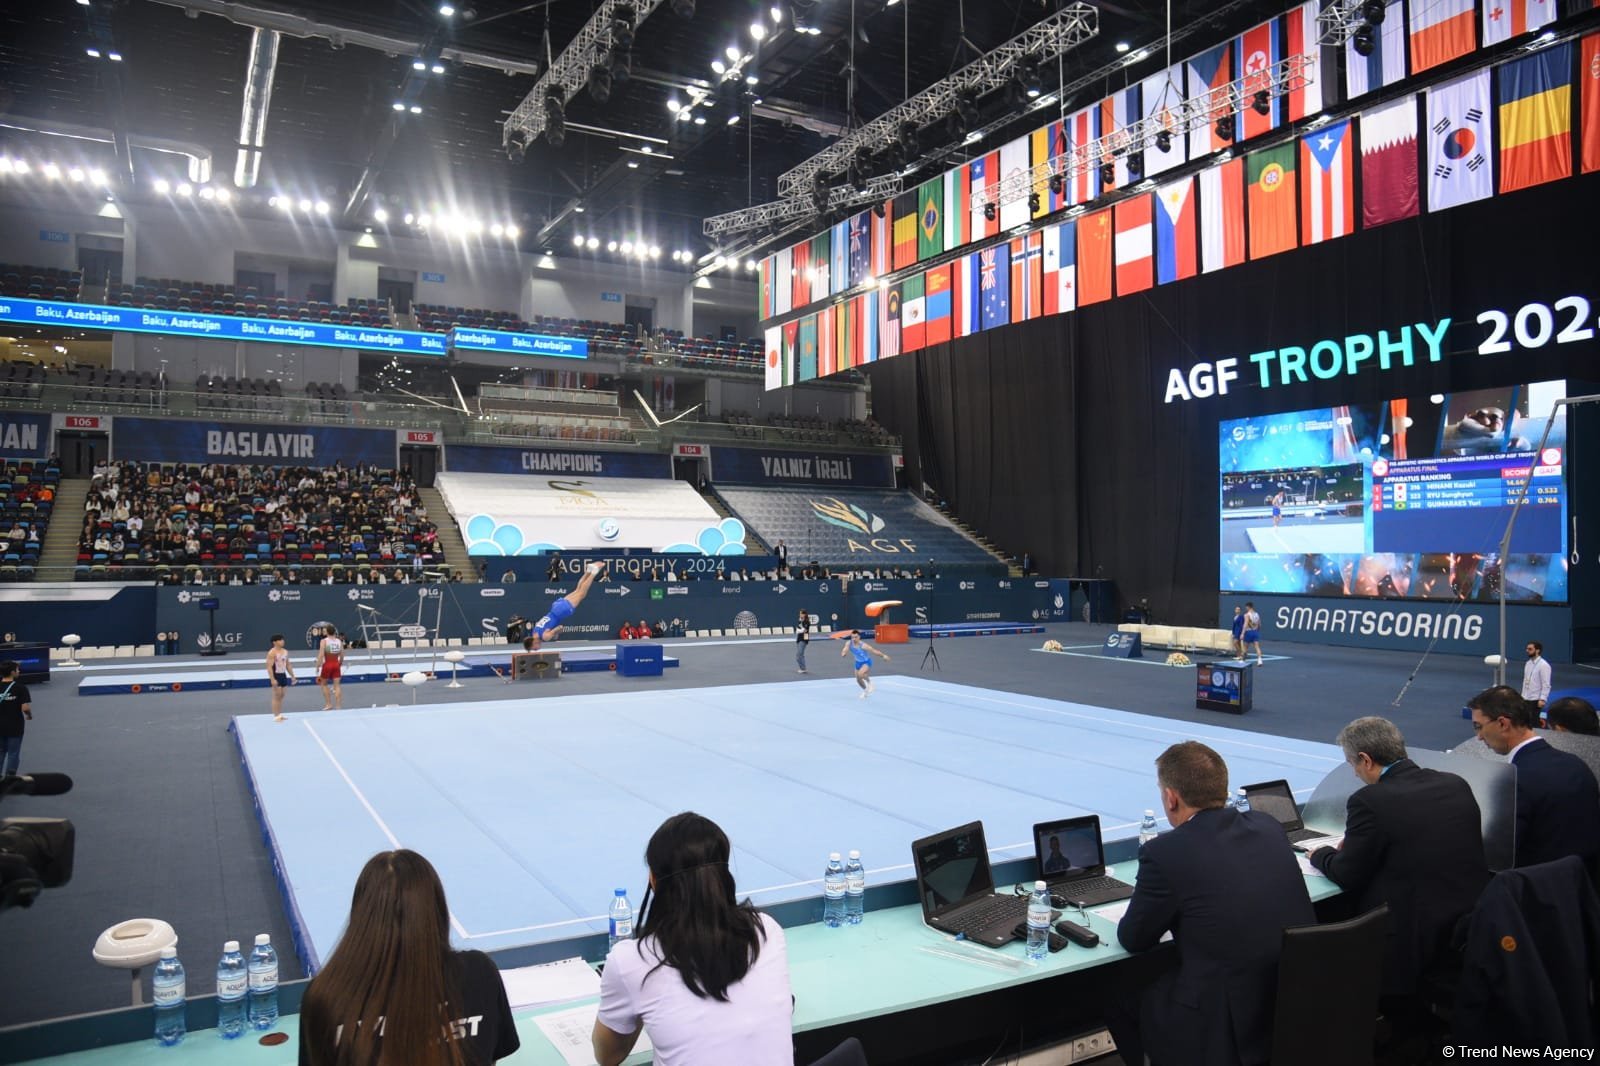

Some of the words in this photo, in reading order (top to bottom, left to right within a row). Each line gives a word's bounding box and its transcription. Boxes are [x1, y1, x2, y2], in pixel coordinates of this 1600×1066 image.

[35, 306, 64, 319] Baku,
[65, 309, 120, 324] Azerbaijan
[142, 314, 169, 327] Baku,
[170, 317, 221, 332] Azerbaijan
[241, 323, 266, 335] Baku,
[268, 325, 315, 340] Azerbaijan
[334, 330, 357, 342] Baku,
[358, 333, 404, 347] Azerbaijan
[421, 337, 443, 349] Baku,
[454, 333, 496, 346] Azerbaijan
[512, 337, 531, 348] Baku,
[533, 340, 572, 352] Azerbaijan
[1164, 357, 1239, 403] AGF
[1249, 317, 1452, 388] TROPHY
[1476, 295, 1600, 356] 202
[73, 417, 92, 426] 106
[0, 423, 38, 450] AN
[207, 430, 314, 459] BAŞLAYIR
[413, 433, 429, 441] 105
[683, 446, 697, 454] 104
[521, 451, 603, 473] CHAMPIONS
[761, 456, 813, 479] YALNIZ
[1383, 475, 1419, 483] APPARATUS
[1420, 473, 1452, 481] RANKING
[847, 538, 917, 553] AGF
[604, 558, 678, 574] TROPHY
[687, 558, 726, 574] 2024
[1275, 606, 1483, 641] SMARTSCORING
[215, 632, 243, 642] AGF
